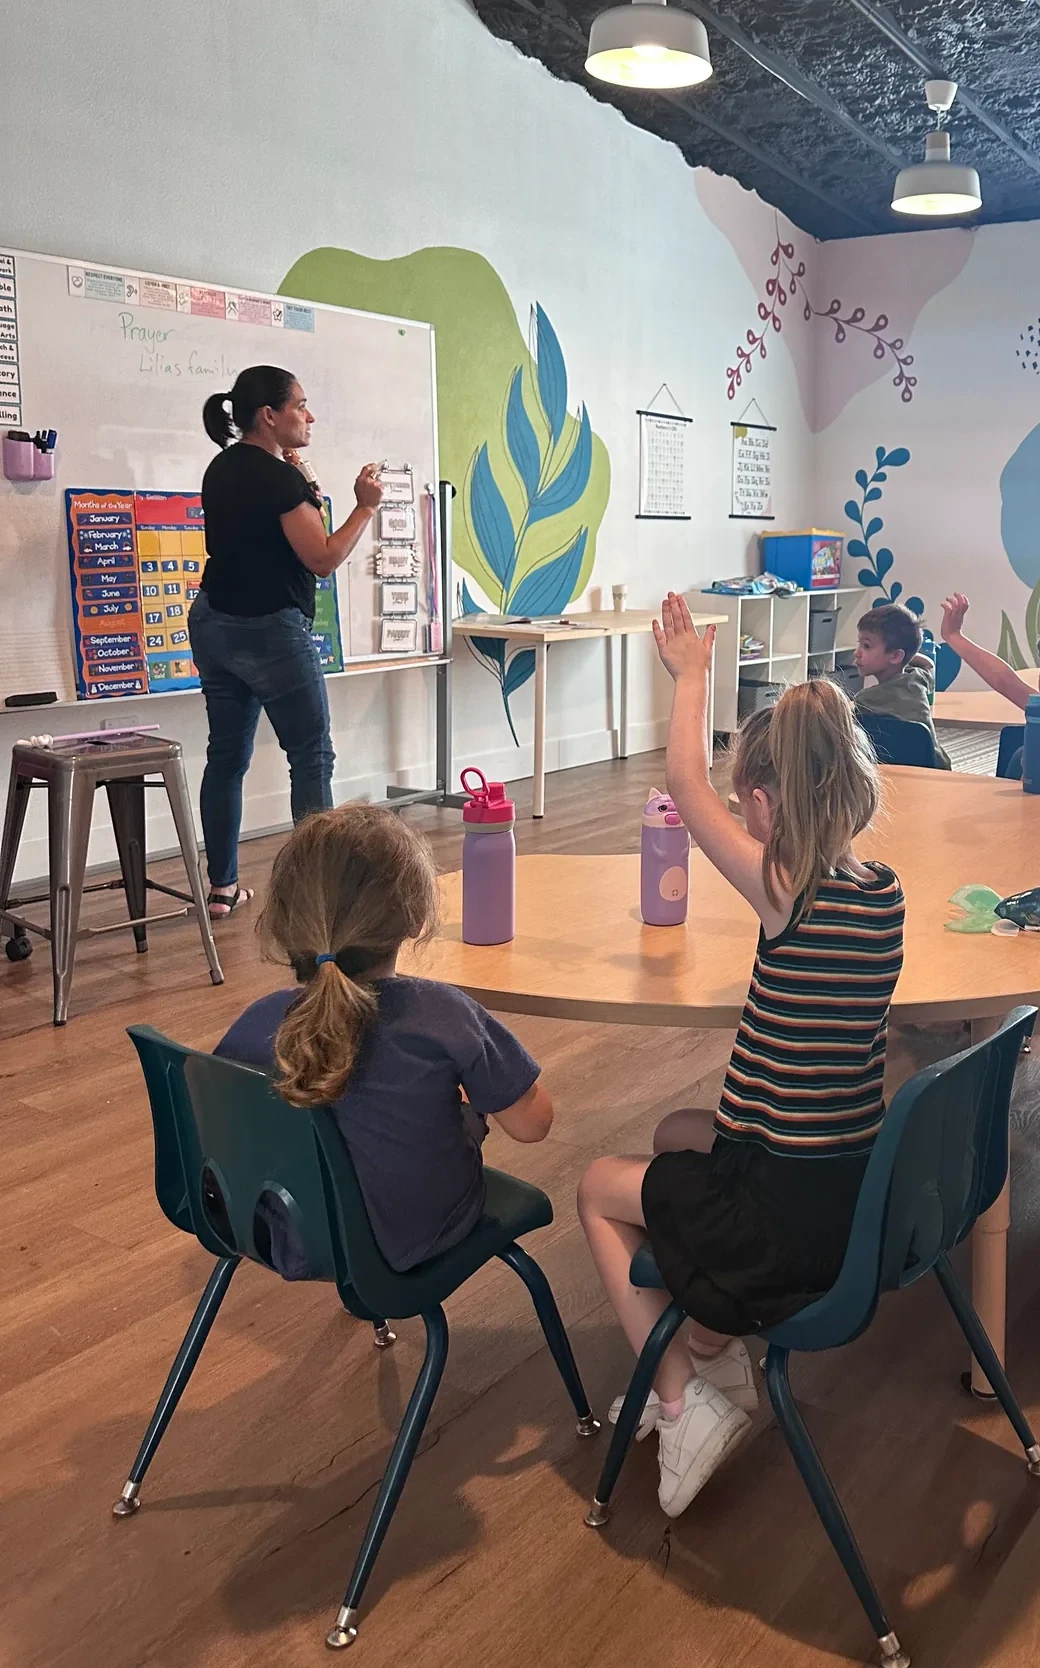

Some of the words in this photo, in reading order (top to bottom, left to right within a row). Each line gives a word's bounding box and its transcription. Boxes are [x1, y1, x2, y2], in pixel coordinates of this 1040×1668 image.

[118, 311, 174, 353] Prayer
[90, 514, 120, 523] January
[88, 530, 122, 540] February
[95, 541, 119, 551] March
[97, 556, 115, 568] April
[147, 562, 154, 572] 3
[167, 562, 174, 571] 4
[188, 561, 195, 571] 5
[101, 574, 117, 584] May
[101, 589, 120, 598] June
[145, 586, 157, 596] 10
[168, 584, 178, 594] 11
[103, 604, 120, 614] July
[148, 613, 160, 623] 17
[169, 605, 182, 616] 18
[90, 635, 132, 646] September
[149, 636, 162, 646] 24
[173, 631, 187, 643] 25
[97, 648, 130, 658] October
[98, 663, 135, 673] November
[98, 680, 135, 692] December
